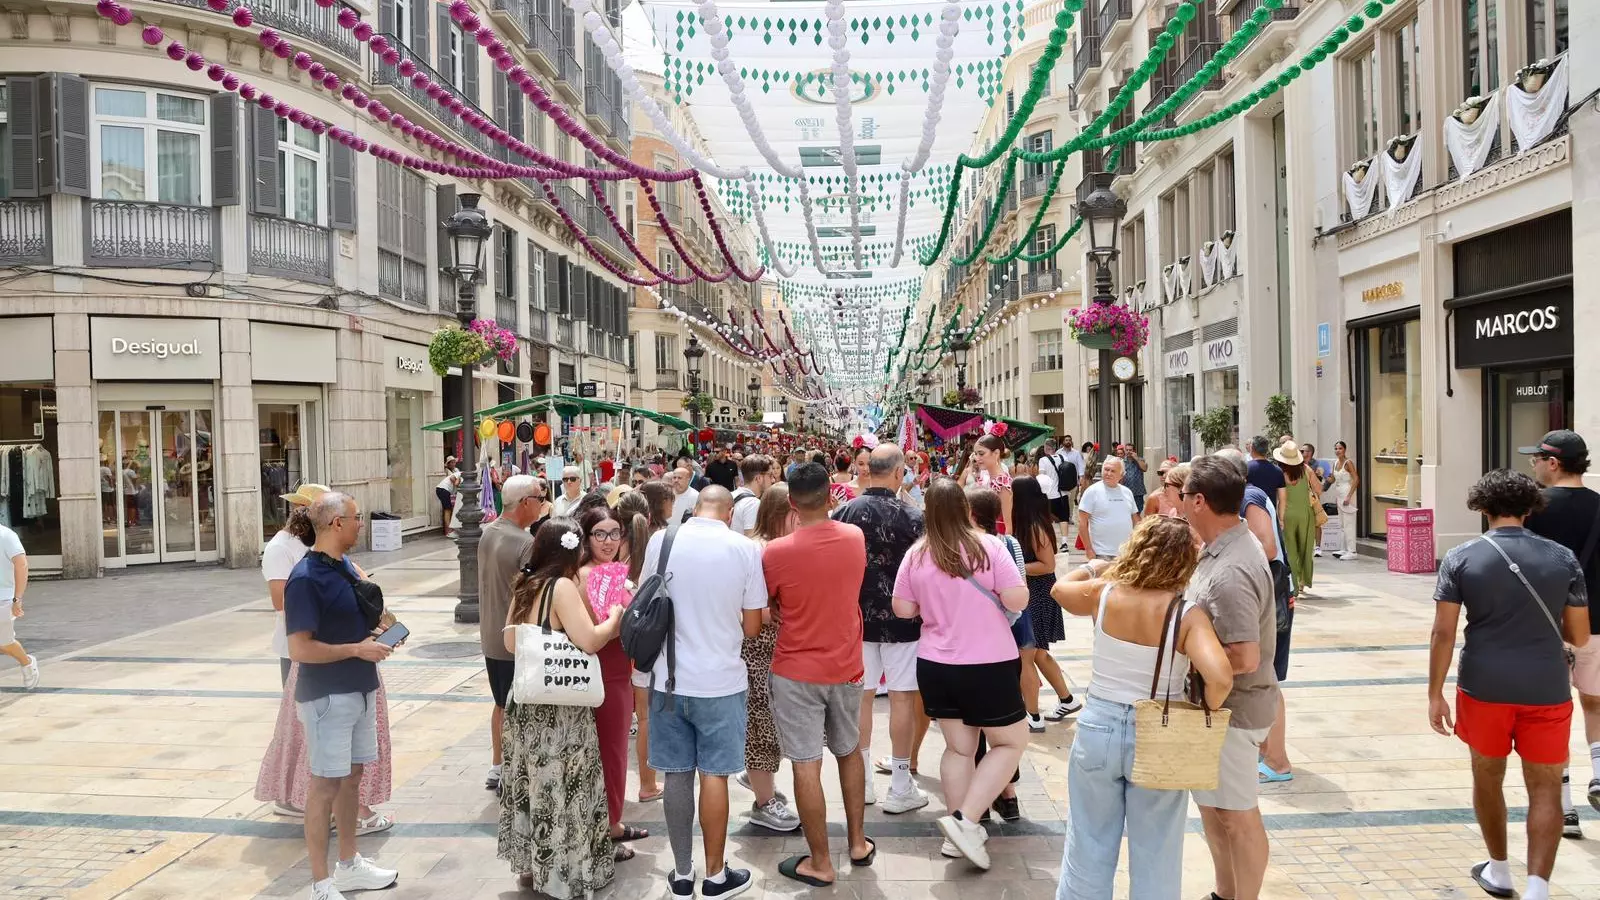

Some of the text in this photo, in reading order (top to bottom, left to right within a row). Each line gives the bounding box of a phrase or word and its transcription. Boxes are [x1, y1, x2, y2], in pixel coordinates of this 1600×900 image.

[1475, 305, 1559, 340] MARCOS
[1207, 339, 1233, 361] KIKO
[1169, 350, 1189, 370] KIKO
[1516, 385, 1548, 396] HUBLOT
[544, 658, 589, 669] PUPPY
[544, 675, 591, 687] PUPPY
